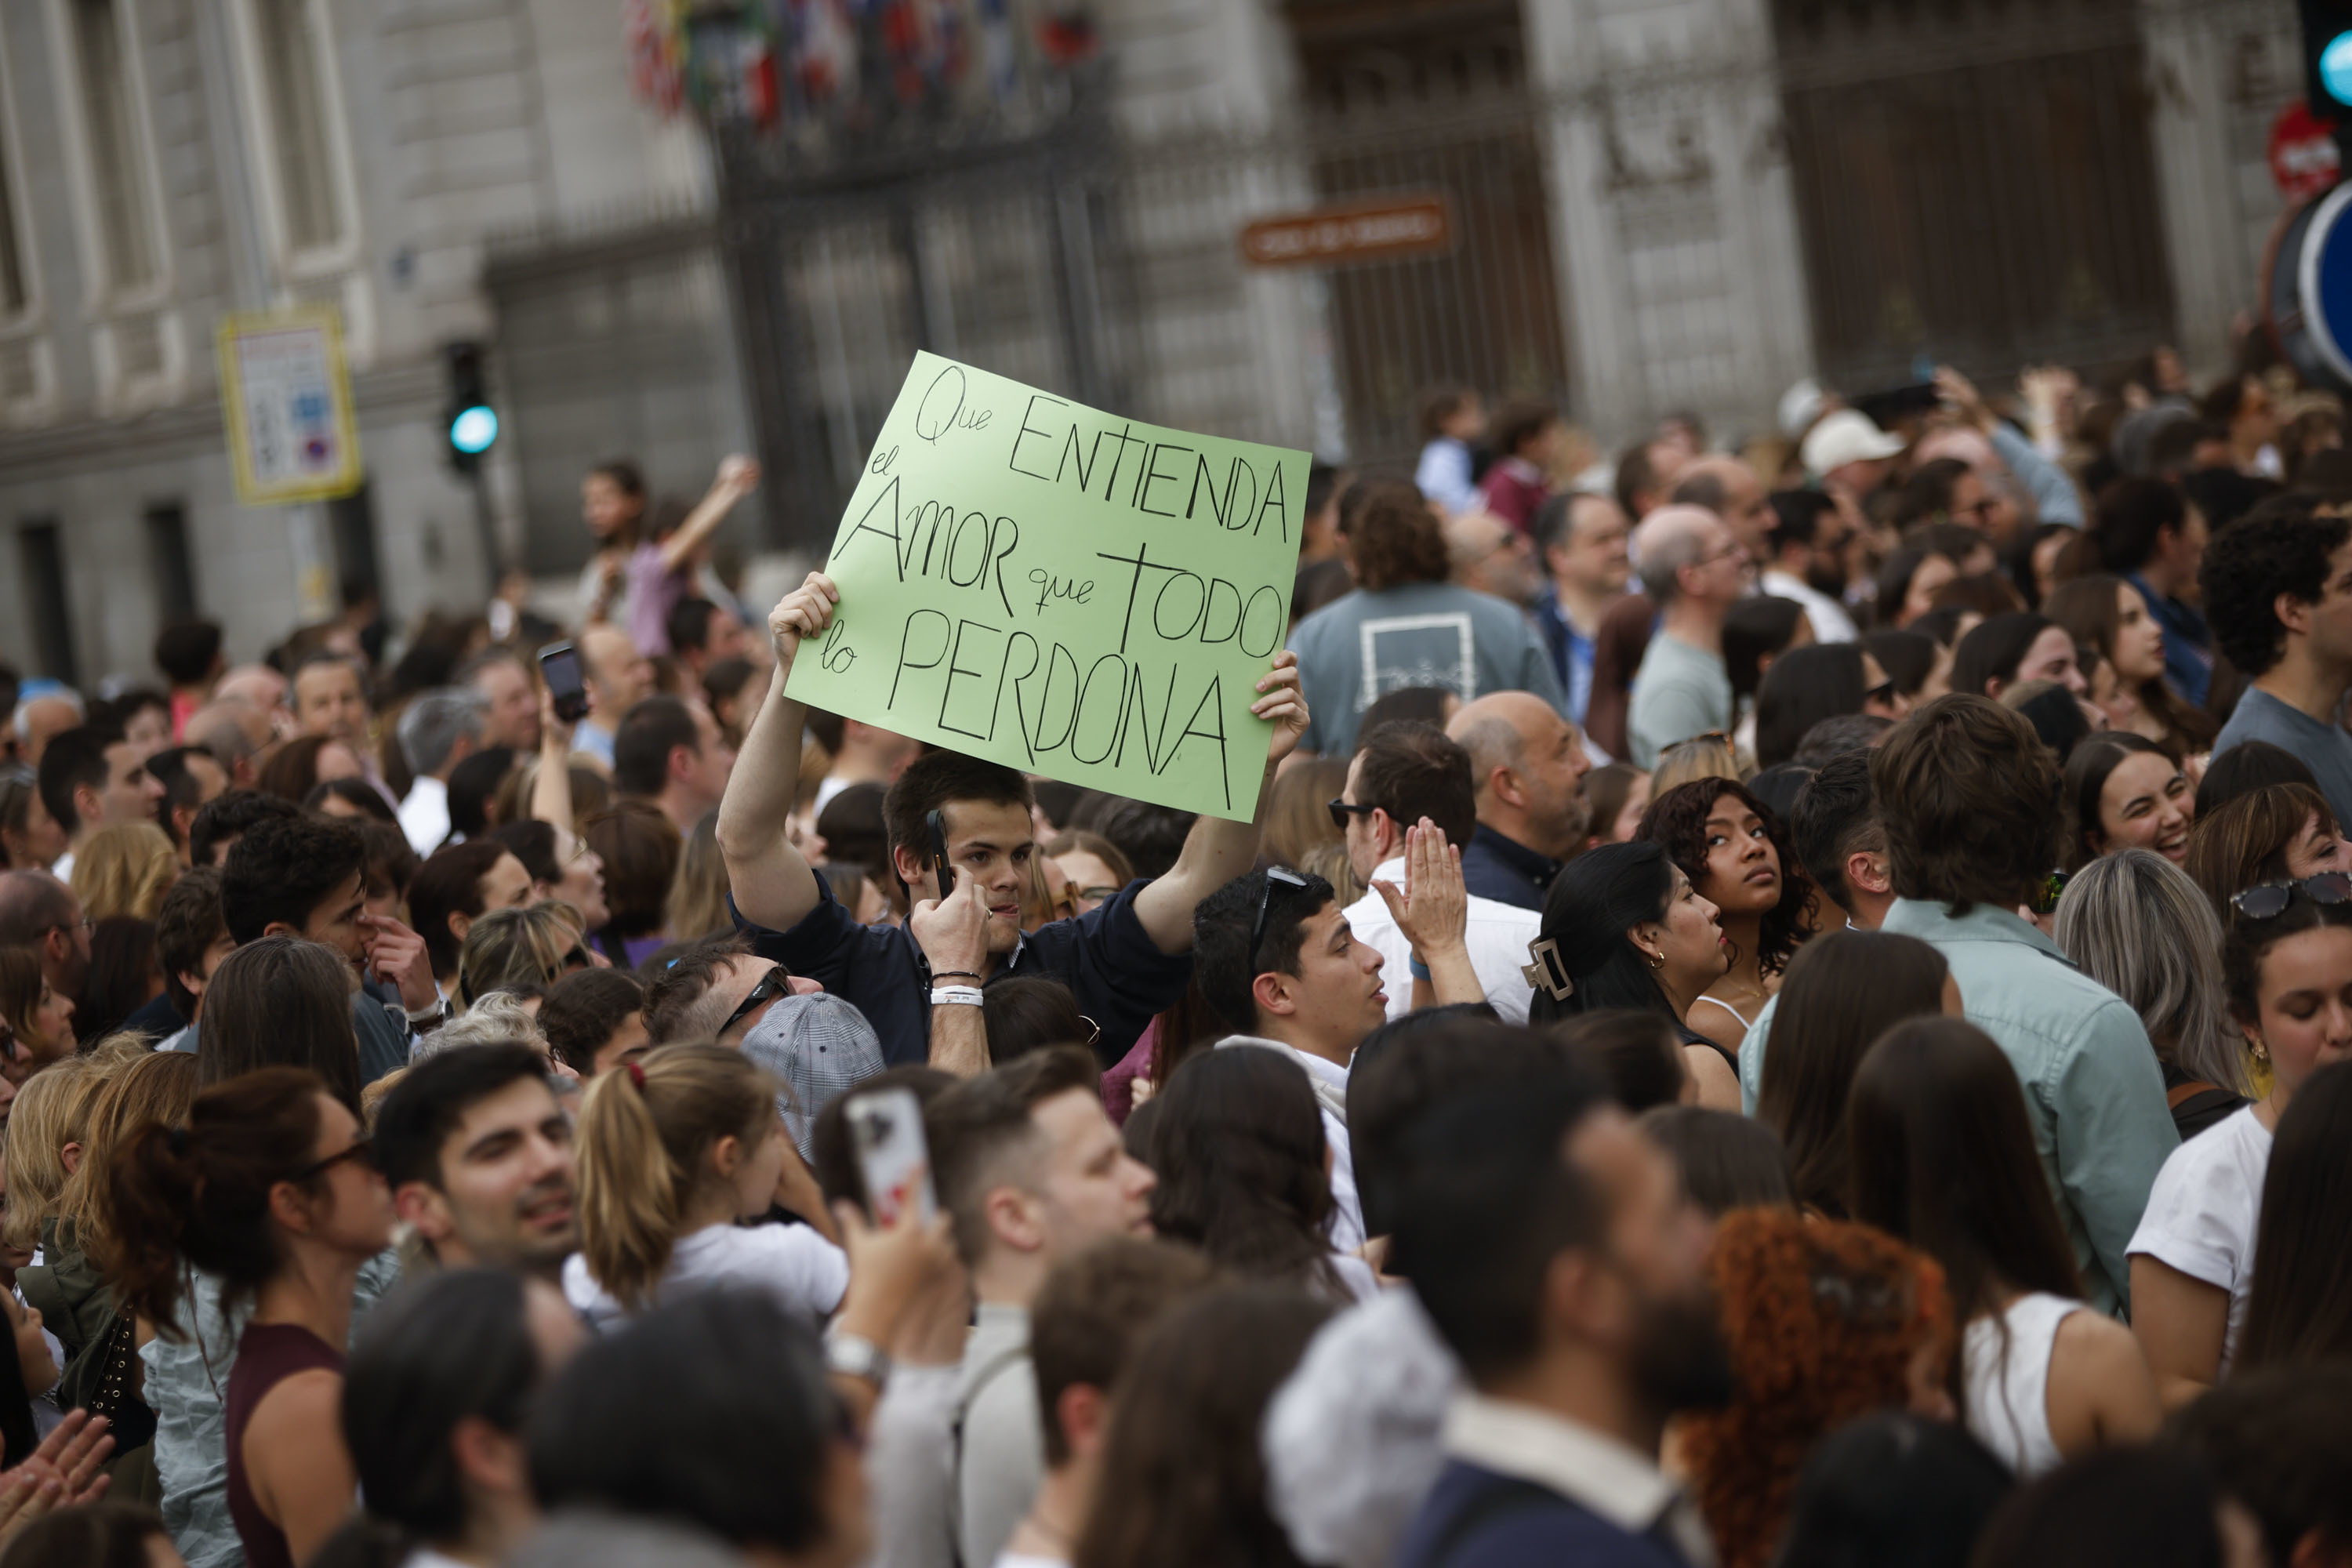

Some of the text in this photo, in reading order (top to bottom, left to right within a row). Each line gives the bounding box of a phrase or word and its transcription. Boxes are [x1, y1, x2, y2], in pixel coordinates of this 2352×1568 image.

[872, 445, 900, 476] el
[915, 365, 1287, 543] Que ENTIENDA
[1028, 568, 1094, 617] que
[1096, 543, 1282, 659] TODO
[819, 609, 1231, 811] lo PERDONA
